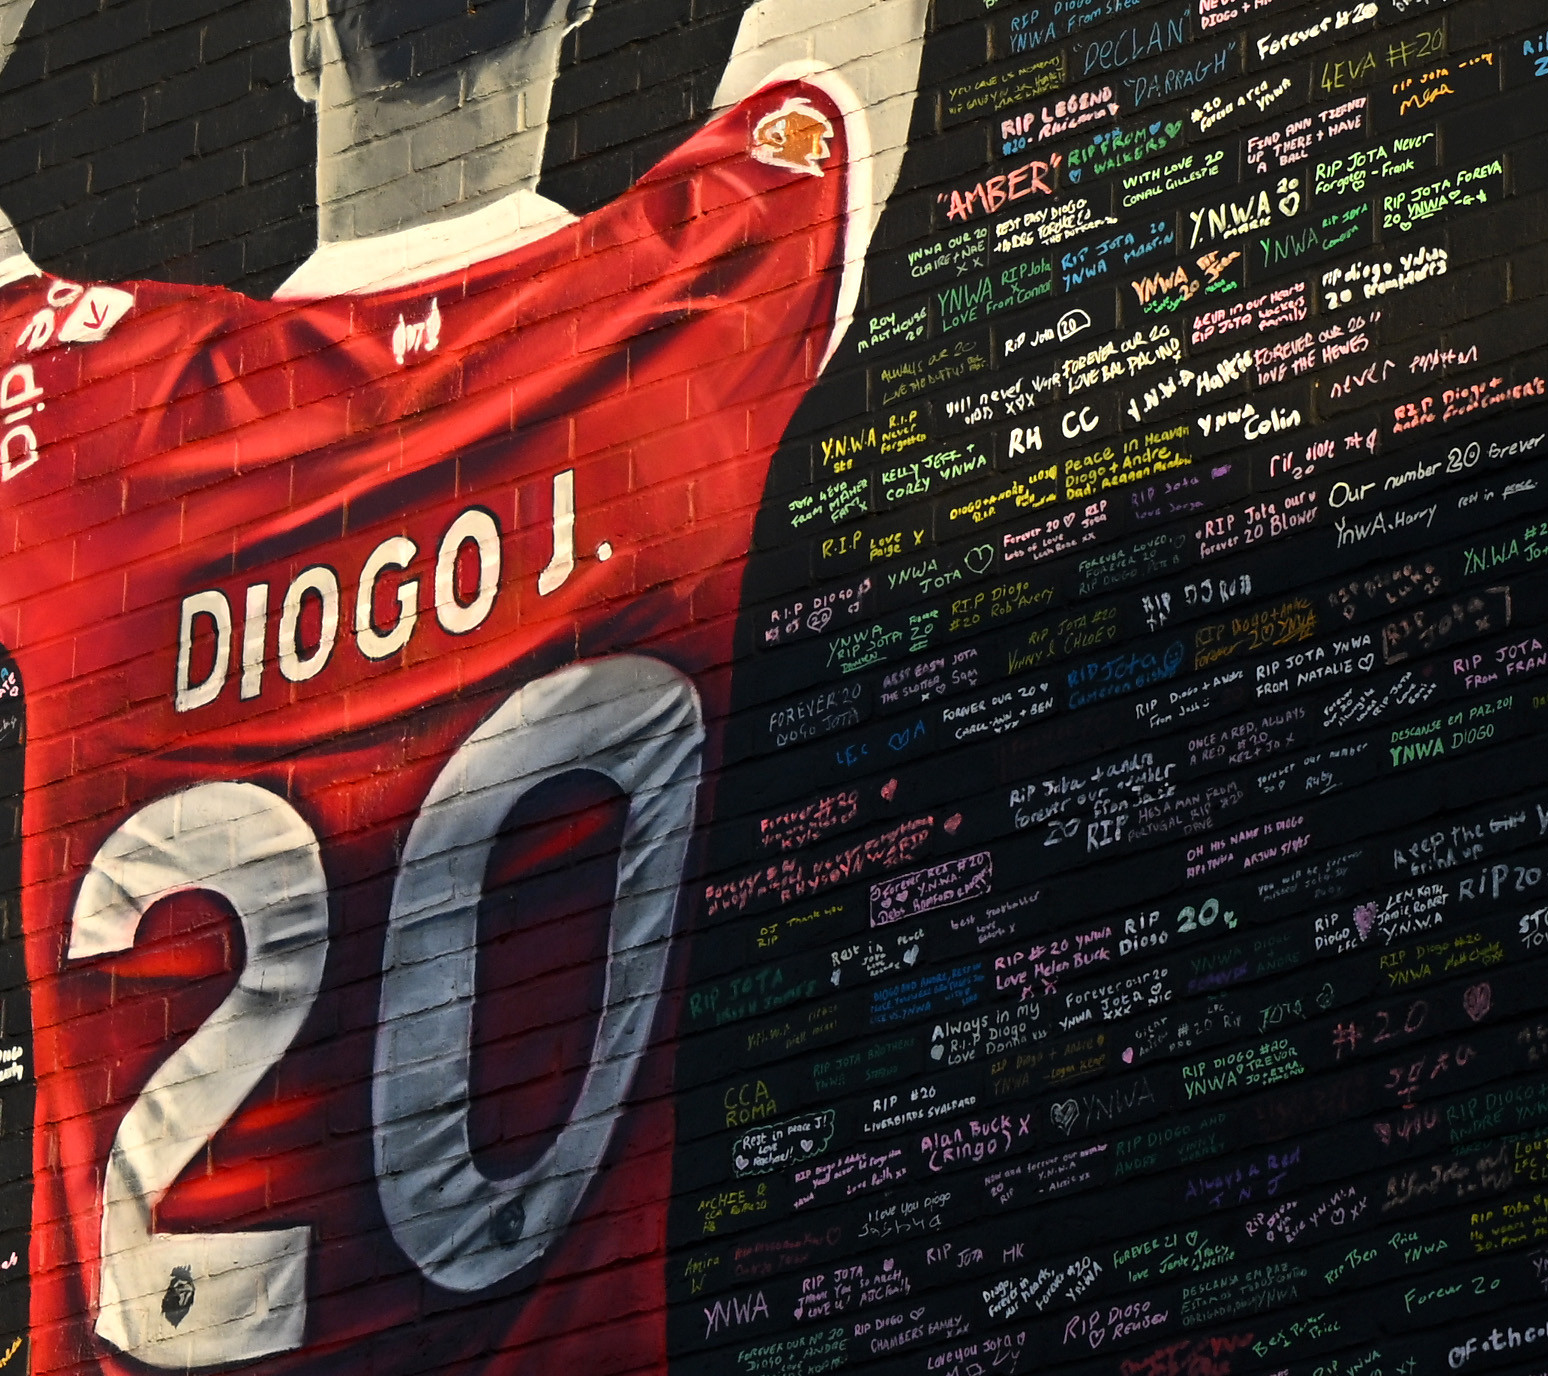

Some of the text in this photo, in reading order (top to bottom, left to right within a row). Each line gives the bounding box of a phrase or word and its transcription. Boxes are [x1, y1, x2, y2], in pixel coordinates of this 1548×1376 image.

[1321, 32, 1444, 92] 4EVA #20
[1001, 113, 1034, 142] RIP
[1009, 407, 1099, 457] RH CC
[1329, 482, 1375, 508] Our
[1384, 462, 1441, 490] number
[1446, 442, 1480, 473] 20
[171, 470, 614, 714] DIOGO J.
[1391, 738, 1444, 766] YNWA
[66, 650, 708, 1372] 20
[1083, 1077, 1155, 1127] YNWA
[704, 1291, 768, 1339] YNWA
